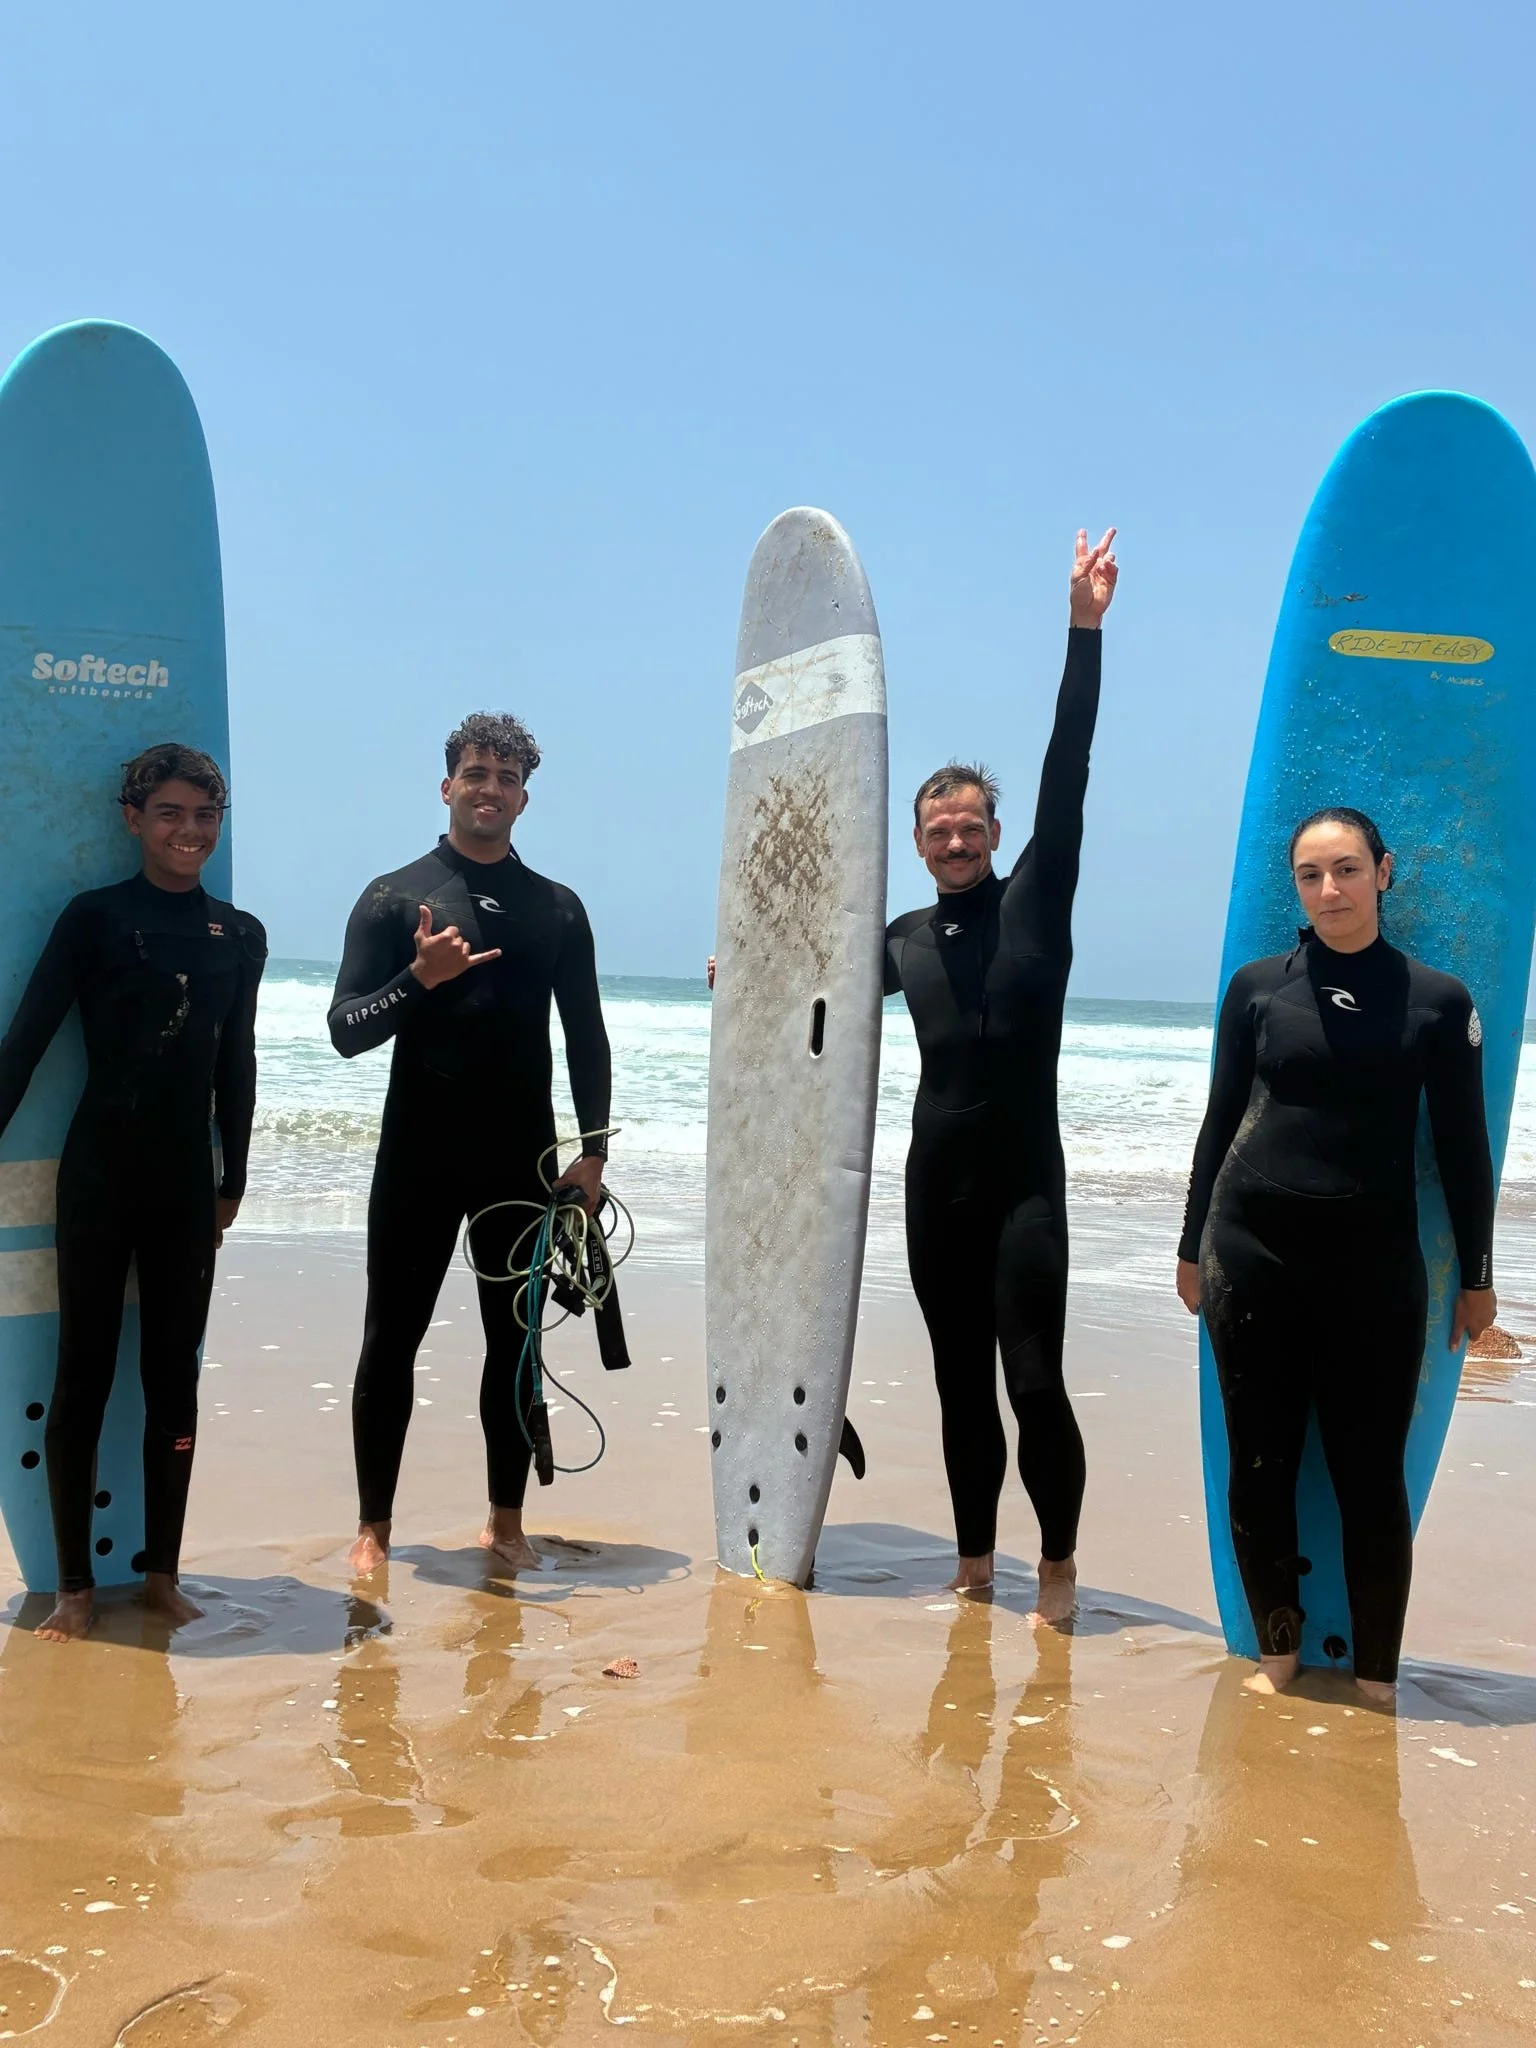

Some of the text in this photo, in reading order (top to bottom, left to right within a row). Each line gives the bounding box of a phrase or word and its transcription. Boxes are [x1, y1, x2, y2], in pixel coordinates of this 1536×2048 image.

[1337, 634, 1485, 660] RIDE-IT EASY
[32, 652, 168, 687] Softech
[48, 685, 153, 699] softboards
[732, 695, 772, 721] Softech
[346, 988, 407, 1026] RIPCURL
